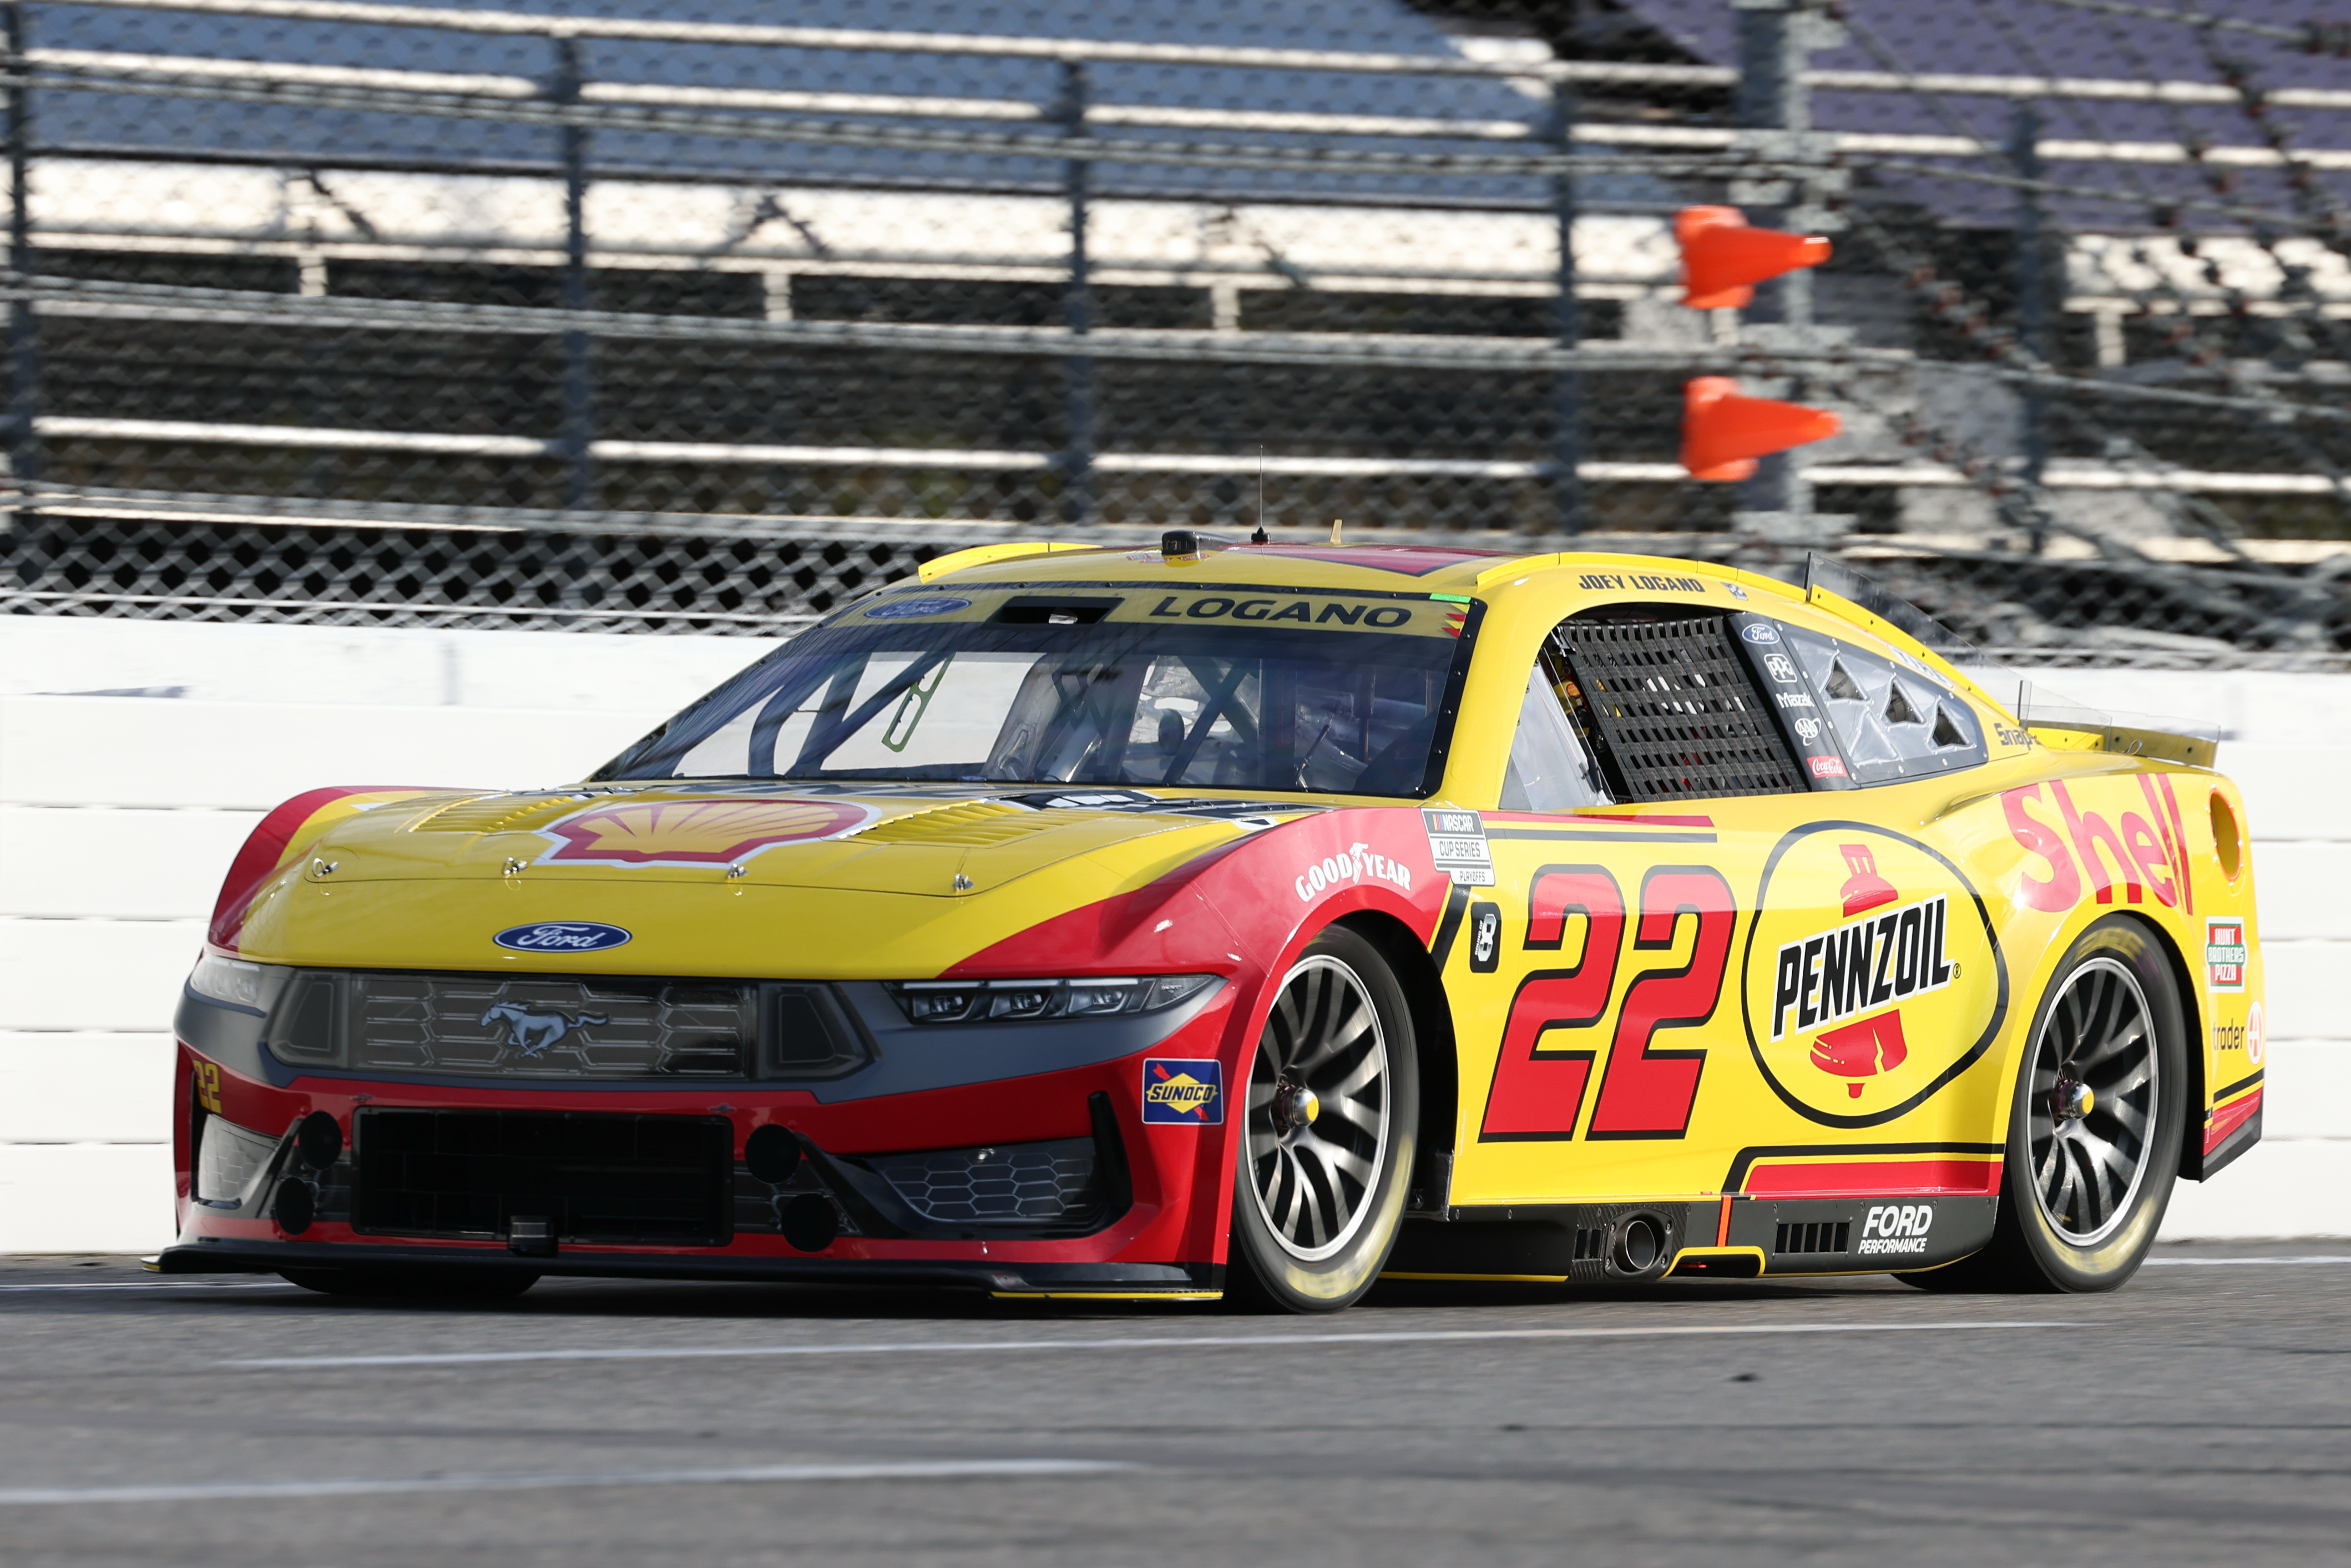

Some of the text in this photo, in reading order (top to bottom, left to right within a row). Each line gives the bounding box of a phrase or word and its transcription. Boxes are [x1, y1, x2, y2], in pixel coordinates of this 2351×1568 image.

[1578, 574, 1706, 593] JOEY LOGANO
[1149, 596, 1412, 628] LOGANO
[1751, 625, 1775, 641] Ford
[1768, 656, 1794, 679] PPG
[1776, 692, 1815, 709] Mazak
[1443, 814, 1475, 832] NASCAR
[1439, 840, 1481, 858] CUP SERIES
[2000, 772, 2194, 916] Shell
[1460, 871, 1486, 882] PLAYOFFS
[516, 925, 607, 948] Ford
[1478, 913, 1497, 962] 8
[2214, 928, 2236, 945] HUNT
[2208, 947, 2244, 963] BROTHERS
[2215, 964, 2237, 981] PIZZA
[1478, 863, 1737, 1143] 22
[192, 1058, 223, 1115] 22
[1150, 1085, 1214, 1101] SUNOCO
[1862, 1205, 1933, 1237] FORD
[1858, 1237, 1928, 1255] PERFORMANCE
